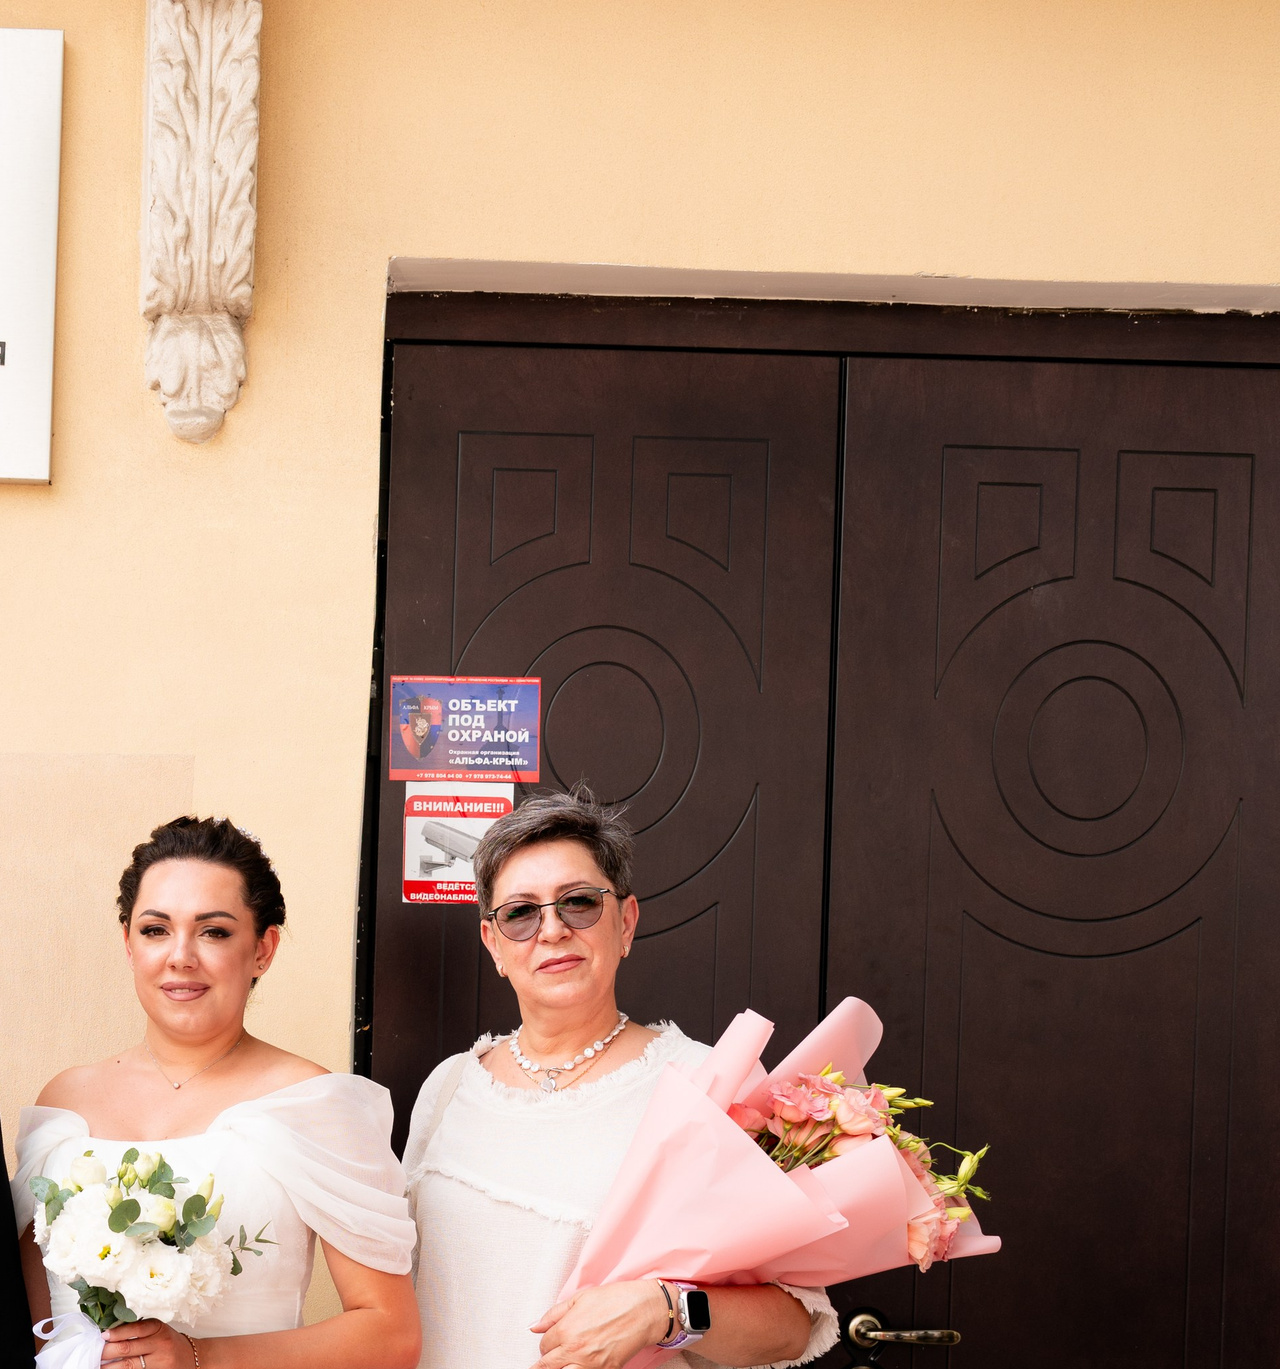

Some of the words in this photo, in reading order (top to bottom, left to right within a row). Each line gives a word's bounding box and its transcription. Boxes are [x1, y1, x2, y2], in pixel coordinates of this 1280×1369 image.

[448, 699, 519, 712] ОБЪЕКТ
[448, 714, 486, 729] ПОД
[448, 728, 530, 743] ОХРАНОЙ
[448, 757, 529, 766] «АЛЬФА-КРЫМ»
[413, 801, 505, 813] ВНИМАНИЕ!!!
